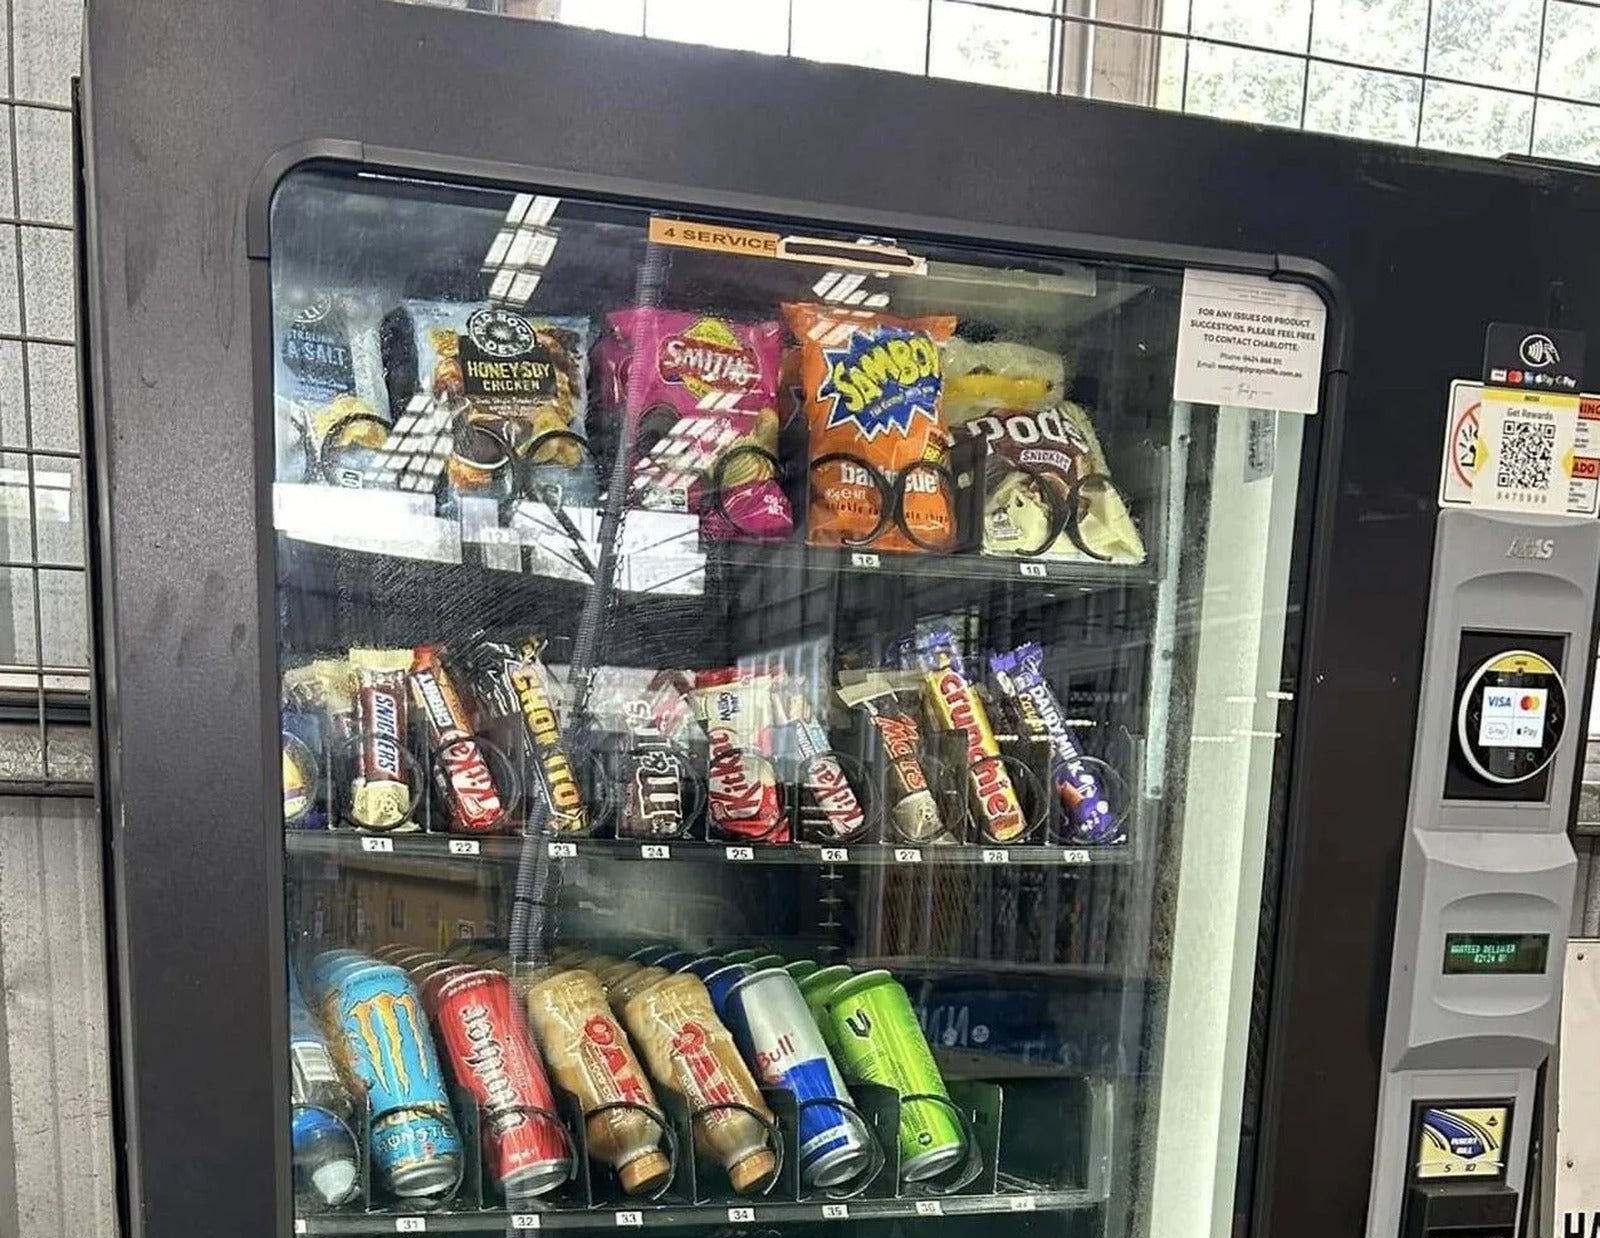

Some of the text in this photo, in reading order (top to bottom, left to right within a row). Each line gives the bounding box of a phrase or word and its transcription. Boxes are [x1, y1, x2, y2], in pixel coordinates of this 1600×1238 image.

[663, 227, 778, 251] 4 SERVICE
[1198, 307, 1311, 328] FOR ANY ISSUES OR PRODUCT
[1247, 326, 1276, 337] PLEASE
[1277, 328, 1295, 339] FEEL
[1296, 331, 1316, 341] FREE
[1203, 333, 1215, 342] TO
[1215, 334, 1252, 346] CONTACT
[467, 360, 551, 379] HONEY SOY
[482, 379, 541, 392] CHICKEN
[1507, 407, 1554, 420] Get Rewards
[1488, 696, 1512, 708] VISA
[1030, 684, 1065, 734] DAIRY
[374, 694, 401, 775] SNICKERS
[1522, 726, 1538, 738] Pay
[875, 712, 927, 789] Mars
[939, 672, 1021, 831] Crunchie
[809, 762, 864, 822] KitKat
[369, 840, 386, 851] 21
[455, 842, 473, 853] 22
[553, 844, 572, 854] 23
[647, 847, 663, 857] 24
[732, 849, 748, 859] 25
[826, 850, 842, 861] 26
[900, 851, 916, 861] 27
[988, 851, 1004, 861] 28
[1069, 851, 1084, 861] 29
[756, 1033, 796, 1070] Bull
[1450, 1137, 1477, 1146] INSERT
[1455, 1146, 1473, 1155] BILL
[1443, 1163, 1477, 1173] 5 10
[733, 1210, 749, 1221] 34
[827, 1206, 843, 1217] 35
[403, 1219, 418, 1230] 31
[517, 1216, 535, 1227] 32
[621, 1214, 638, 1225] 33
